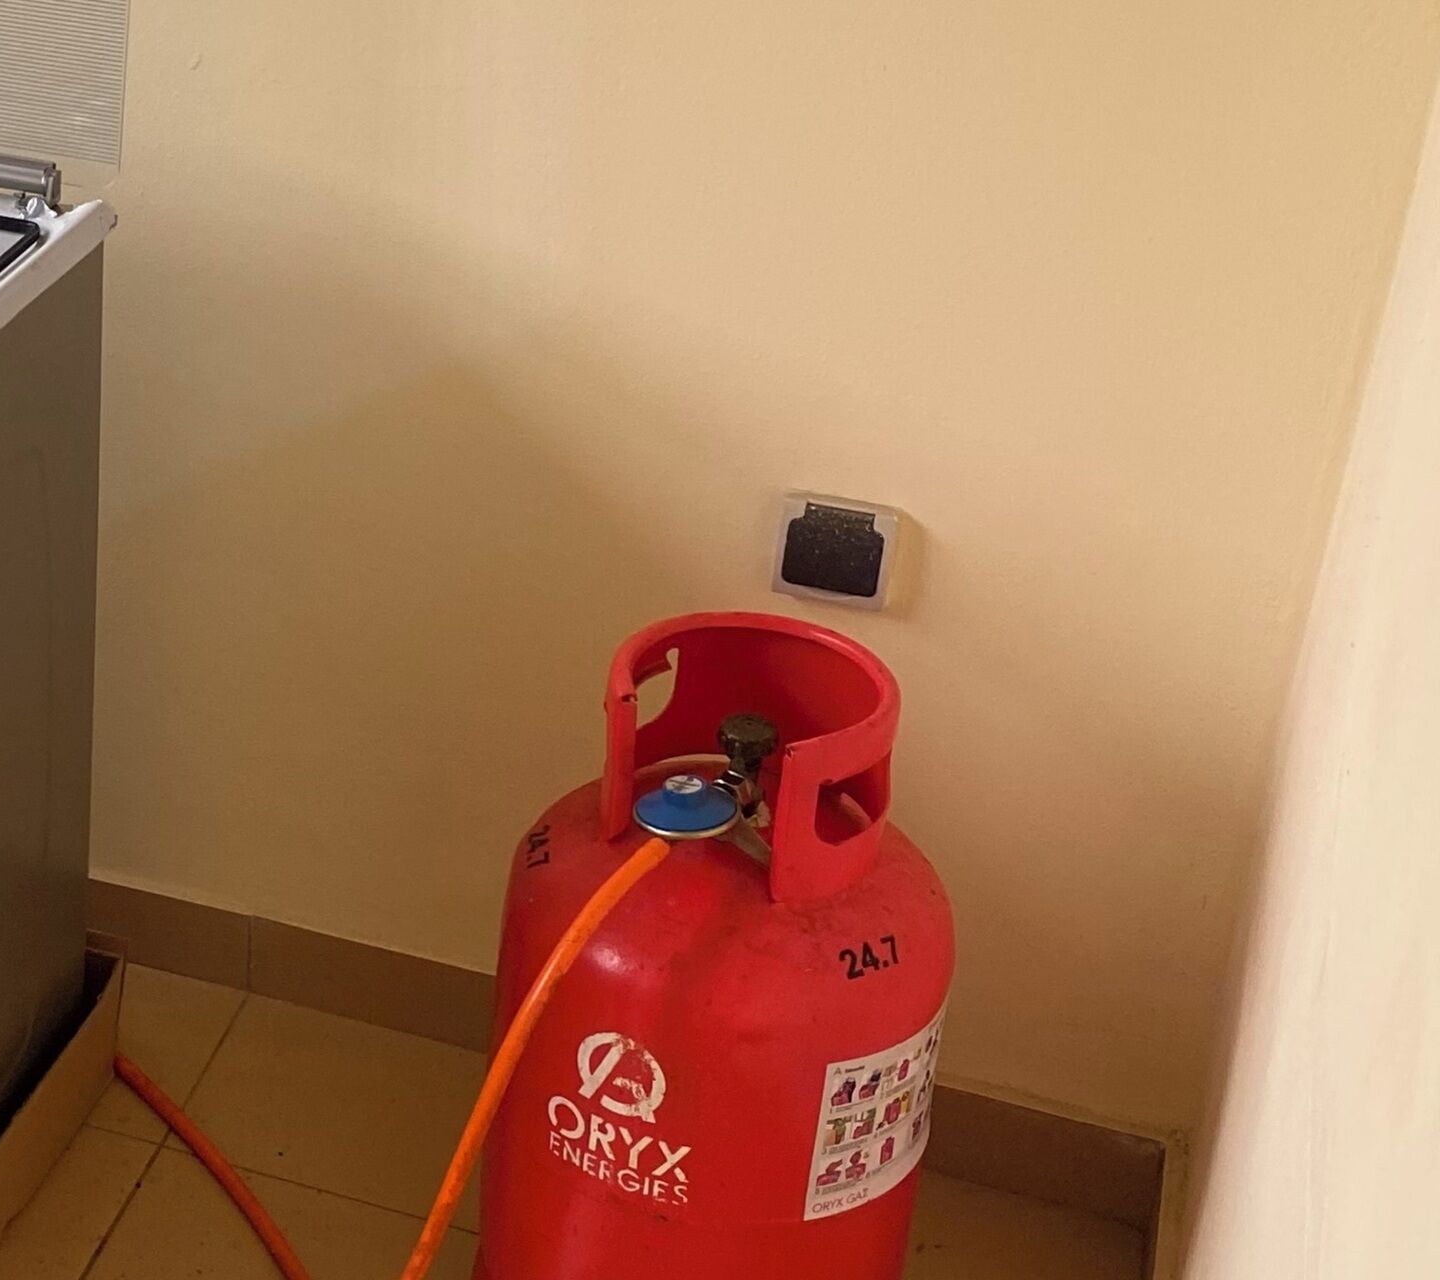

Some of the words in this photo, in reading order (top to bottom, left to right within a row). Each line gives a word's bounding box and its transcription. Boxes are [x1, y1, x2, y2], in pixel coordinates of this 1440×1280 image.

[839, 934, 899, 980] 24.7
[547, 1095, 692, 1184] ORYX
[549, 1130, 689, 1206] ENERGIES
[812, 1197, 844, 1214] ORYX
